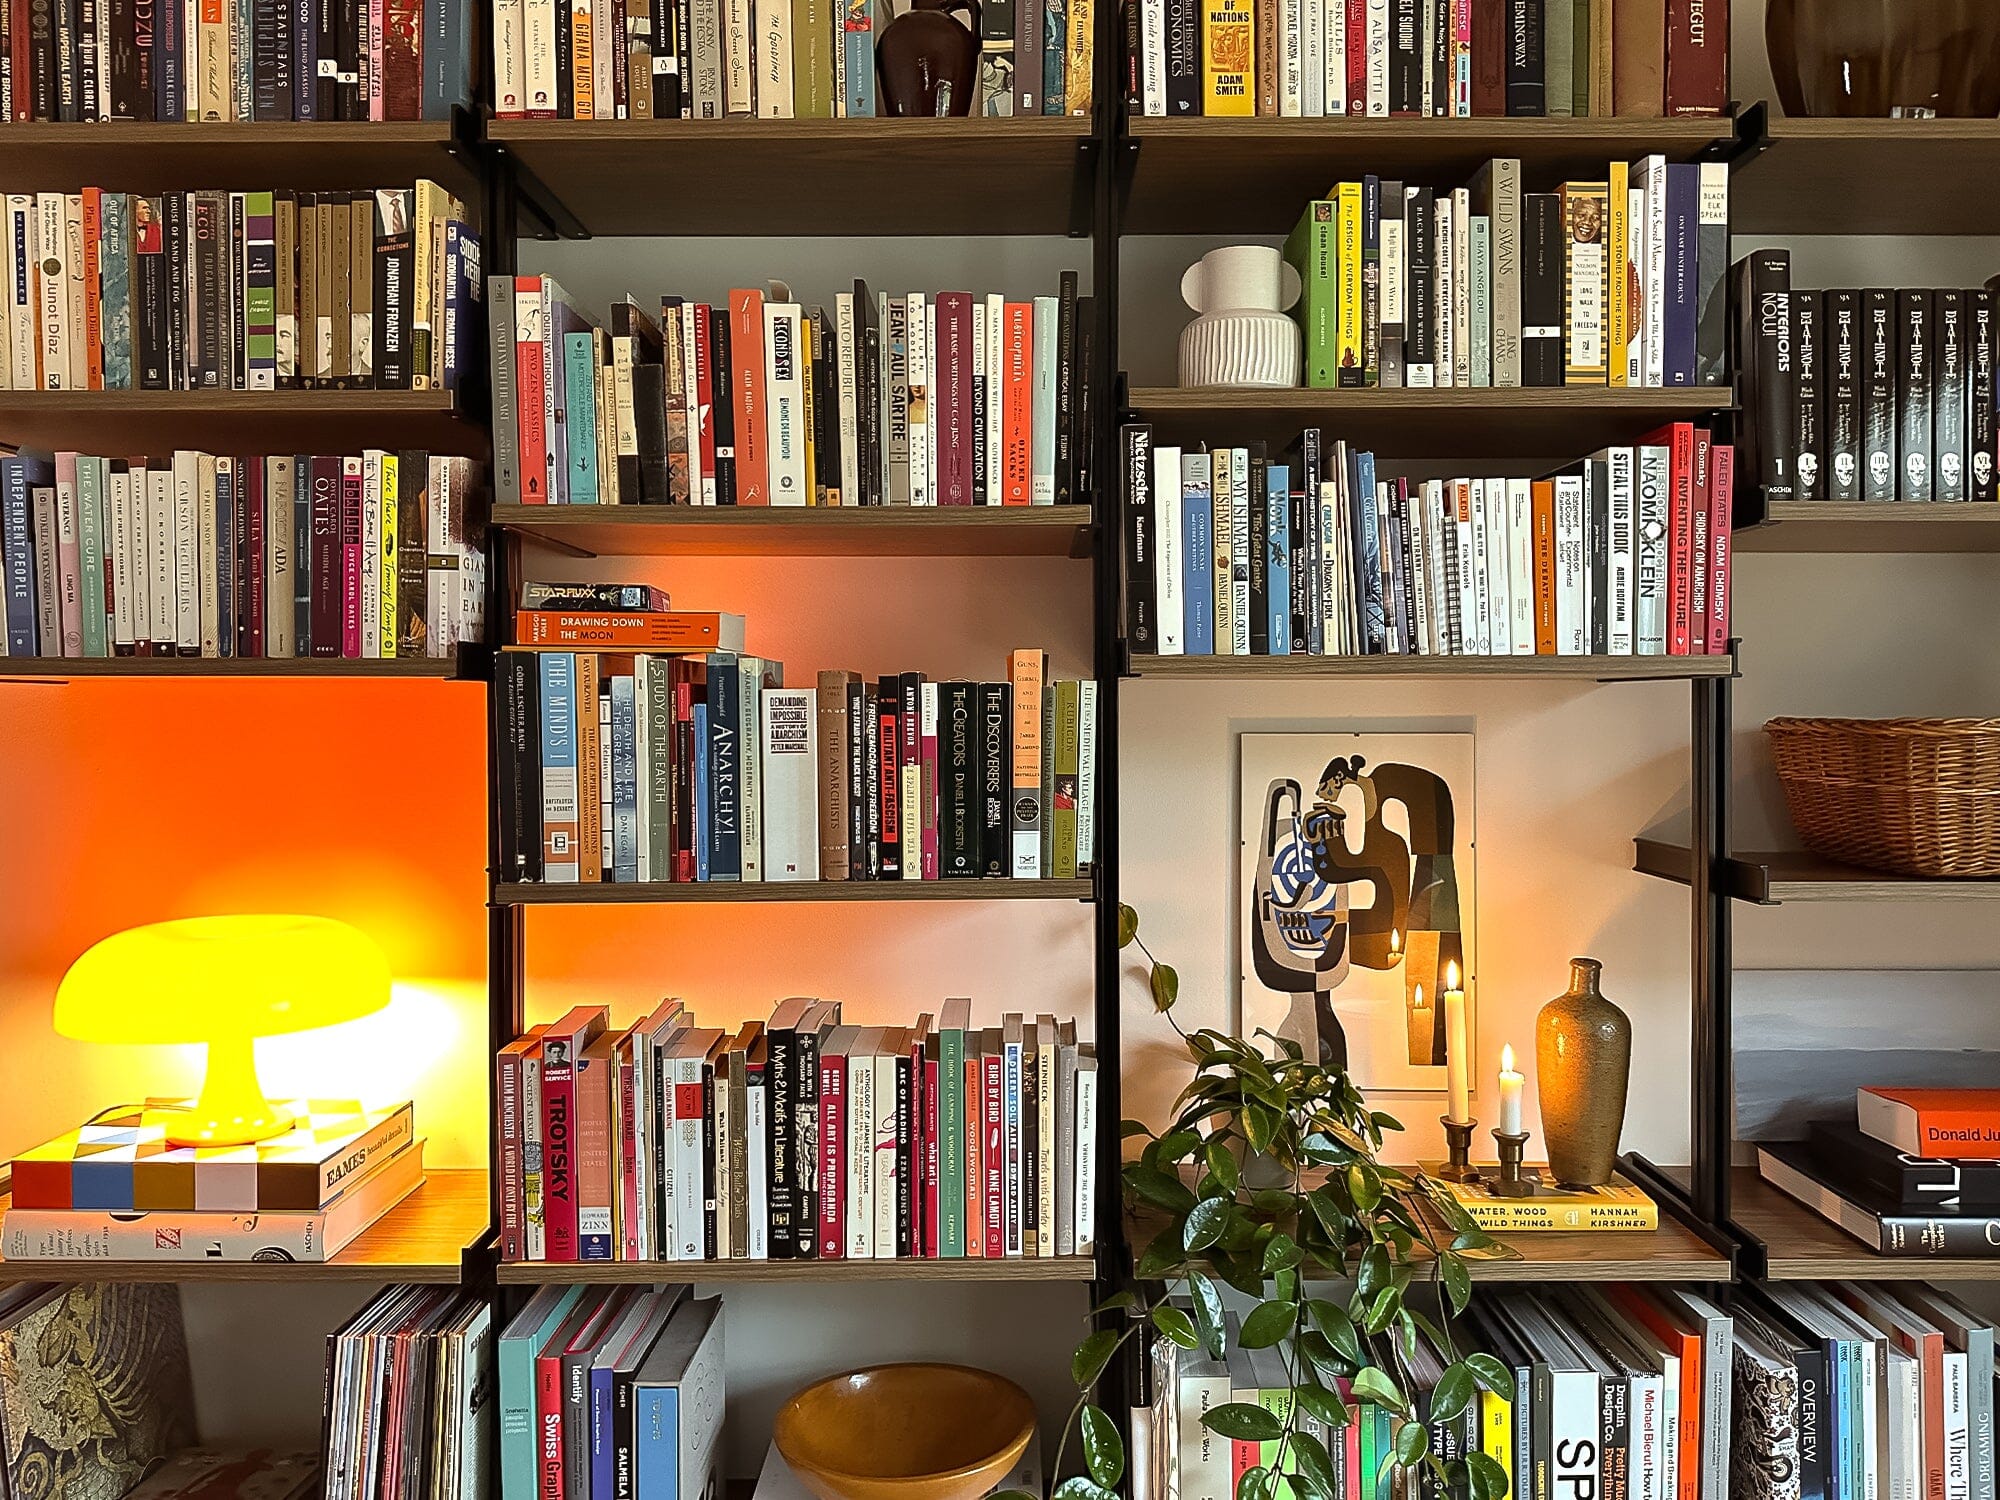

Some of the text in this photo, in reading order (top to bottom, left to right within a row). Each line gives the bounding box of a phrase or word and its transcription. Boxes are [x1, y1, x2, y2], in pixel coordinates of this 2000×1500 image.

[1211, 0, 1249, 23] OF NATIONS
[60, 28, 72, 105] IMPERIAL EARTH
[83, 33, 94, 110] ARTHUR C. CLARKE
[575, 23, 592, 115] GHANA MUST GO
[1147, 10, 1159, 92] Guide to Investing
[1216, 75, 1243, 85] ADAM
[1373, 20, 1383, 93] ALISA VITTI
[1215, 86, 1245, 96] SMITH
[16, 213, 26, 303] WILLA CATHER
[109, 200, 119, 255] OUT OF AFRICA
[1320, 225, 1329, 279] clean house!
[1345, 253, 1353, 261] of
[1346, 220, 1354, 251] DESIGN
[1499, 177, 1513, 275] WILD SWANS
[386, 256, 400, 352] JONATHAN FRANZEN
[444, 253, 456, 369] SIDDHARTHA HERMANN HESSE
[1476, 240, 1485, 314] MAYA ANGELOU
[46, 278, 62, 355] Junot Díaz
[774, 317, 793, 379] SECOND SEX
[974, 309, 983, 373] DANIEL QUINN
[1761, 292, 1777, 337] NOW!
[1777, 292, 1789, 372] INTERIORS
[542, 311, 554, 419] JOURNEY WITHOUT GOAL
[840, 304, 853, 403] PLATO REPUBLIC
[529, 347, 540, 443] TWO ZEN CLASSICS
[891, 385, 907, 441] SARTRE
[974, 377, 984, 481] BEYOND CIVILIZATION
[1135, 430, 1149, 562] Nietzsche Kaufmann
[1696, 441, 1707, 487] Chomsky
[11, 464, 27, 598] INDEPENDENT PEOPLE
[61, 491, 71, 536] SEVERANCE
[83, 463, 95, 572] THE WATER CURE
[315, 476, 329, 535] OATES
[1269, 489, 1286, 537] Work
[1458, 485, 1468, 520] FAILED IT
[1613, 453, 1628, 554] STEAL THIS BOOK
[1640, 456, 1656, 598] NAOMI KLEIN
[1714, 451, 1728, 621] FAILED STATES NOAM CHOMSKY
[1233, 480, 1247, 649] MY ISHMAEL DANIEL QUINN
[1676, 476, 1688, 629] INVENTING THE FUTURE
[1694, 512, 1706, 613] CHOMSKY ON ANARCHISM
[560, 618, 644, 627] DRAWING DOWN
[560, 631, 613, 640] THE MOON
[547, 657, 567, 688] THE
[549, 695, 568, 747] MIND'S
[653, 670, 666, 803] STUDY OF THE EARTH
[713, 723, 736, 835] ANARCHY!
[829, 729, 840, 829] THE ANARCHISTS
[549, 1095, 569, 1203] TROTSKY
[770, 1045, 787, 1184] Myths & Motifs in Literature
[988, 1065, 1000, 1230] BIRD BY BIRD ANNE LAMOTT
[1928, 1127, 1981, 1141] Donald
[325, 1148, 366, 1189] EAMES
[826, 1104, 836, 1224] ALL ART IS PROPAGANDA
[968, 1121, 978, 1200] woodswoman
[305, 1220, 313, 1254] TASCHEN
[1480, 1219, 1554, 1228] WILD THINGS
[1515, 1207, 1547, 1216] WOOD
[1590, 1208, 1638, 1217] HANNAH
[1590, 1219, 1647, 1228] KIRSHNER
[570, 1365, 583, 1404] Identify
[1603, 1384, 1615, 1444] Design Co.
[1615, 1384, 1626, 1428] Draplin
[1802, 1379, 1816, 1463] OVERVIEW
[545, 1413, 561, 1459] Swiss
[618, 1447, 629, 1497] SALMELA
[1644, 1389, 1655, 1494] Michael Bierut How
[1950, 1428, 1967, 1478] Where
